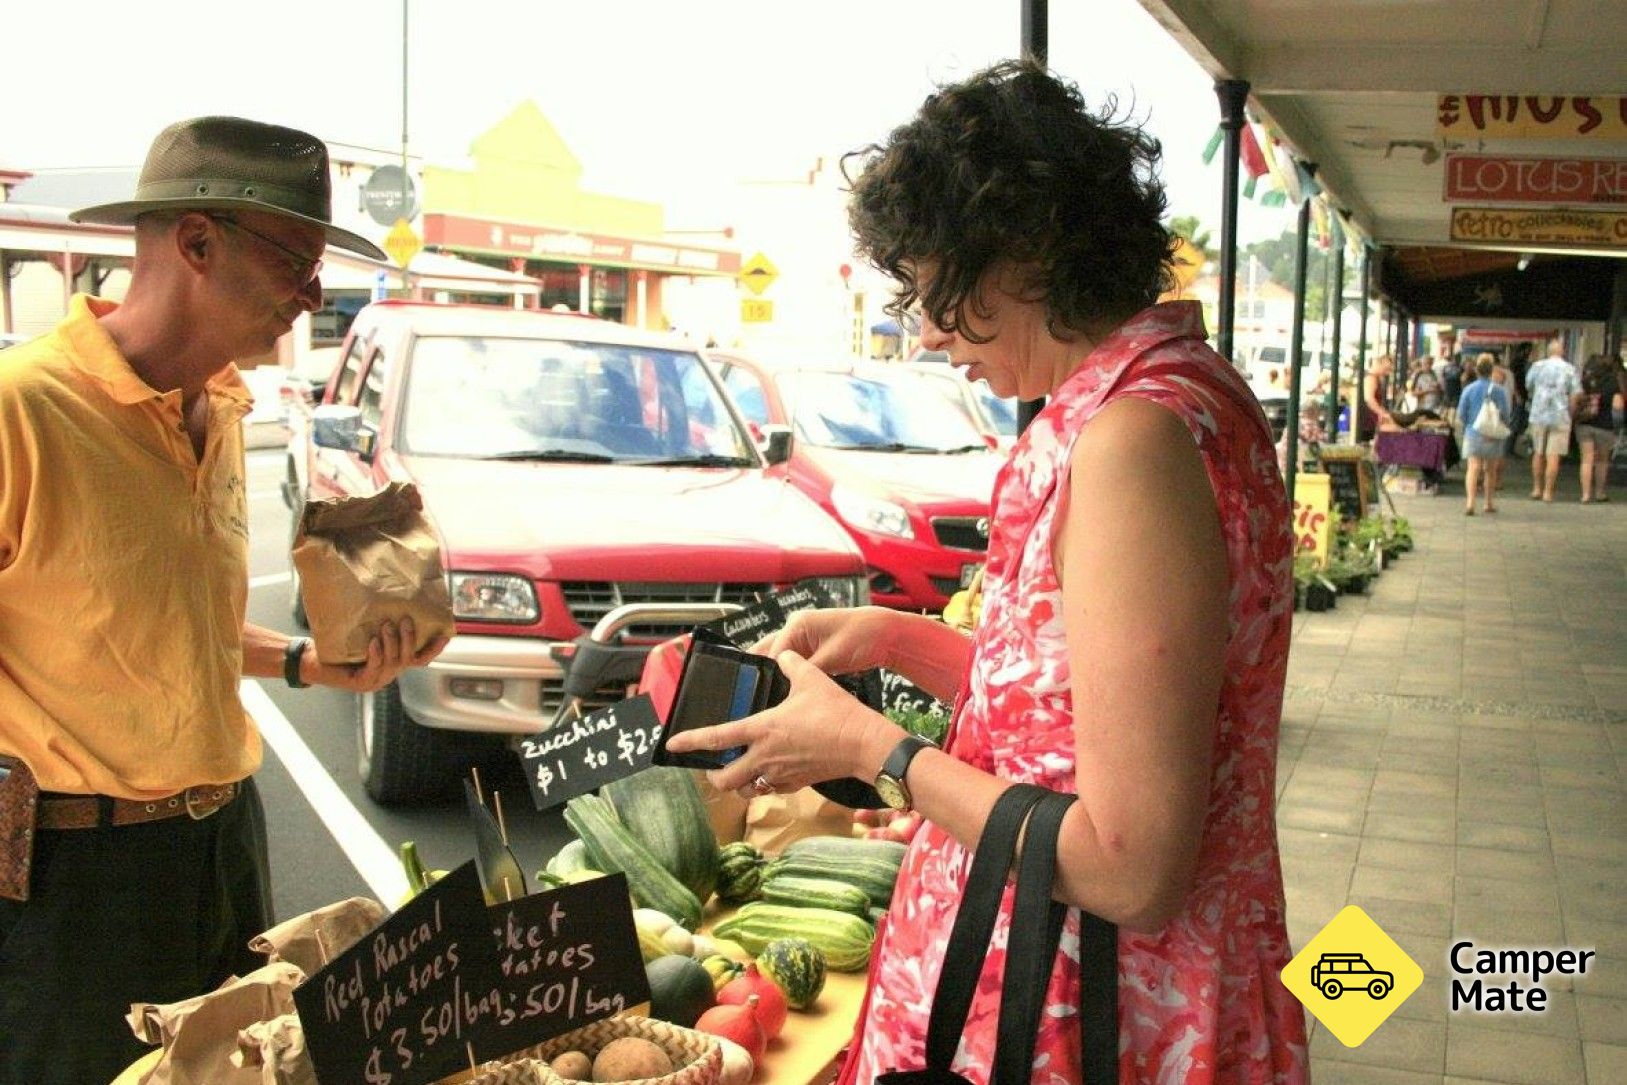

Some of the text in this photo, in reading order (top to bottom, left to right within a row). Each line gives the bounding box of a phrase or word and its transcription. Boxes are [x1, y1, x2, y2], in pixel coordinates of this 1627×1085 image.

[1456, 160, 1583, 193] LOTUS
[520, 707, 617, 759] Zucchini
[537, 759, 567, 796] $1
[584, 746, 608, 769] to
[493, 900, 567, 950] ket
[324, 898, 441, 1024] Red Rascal
[501, 943, 595, 977] tatoes
